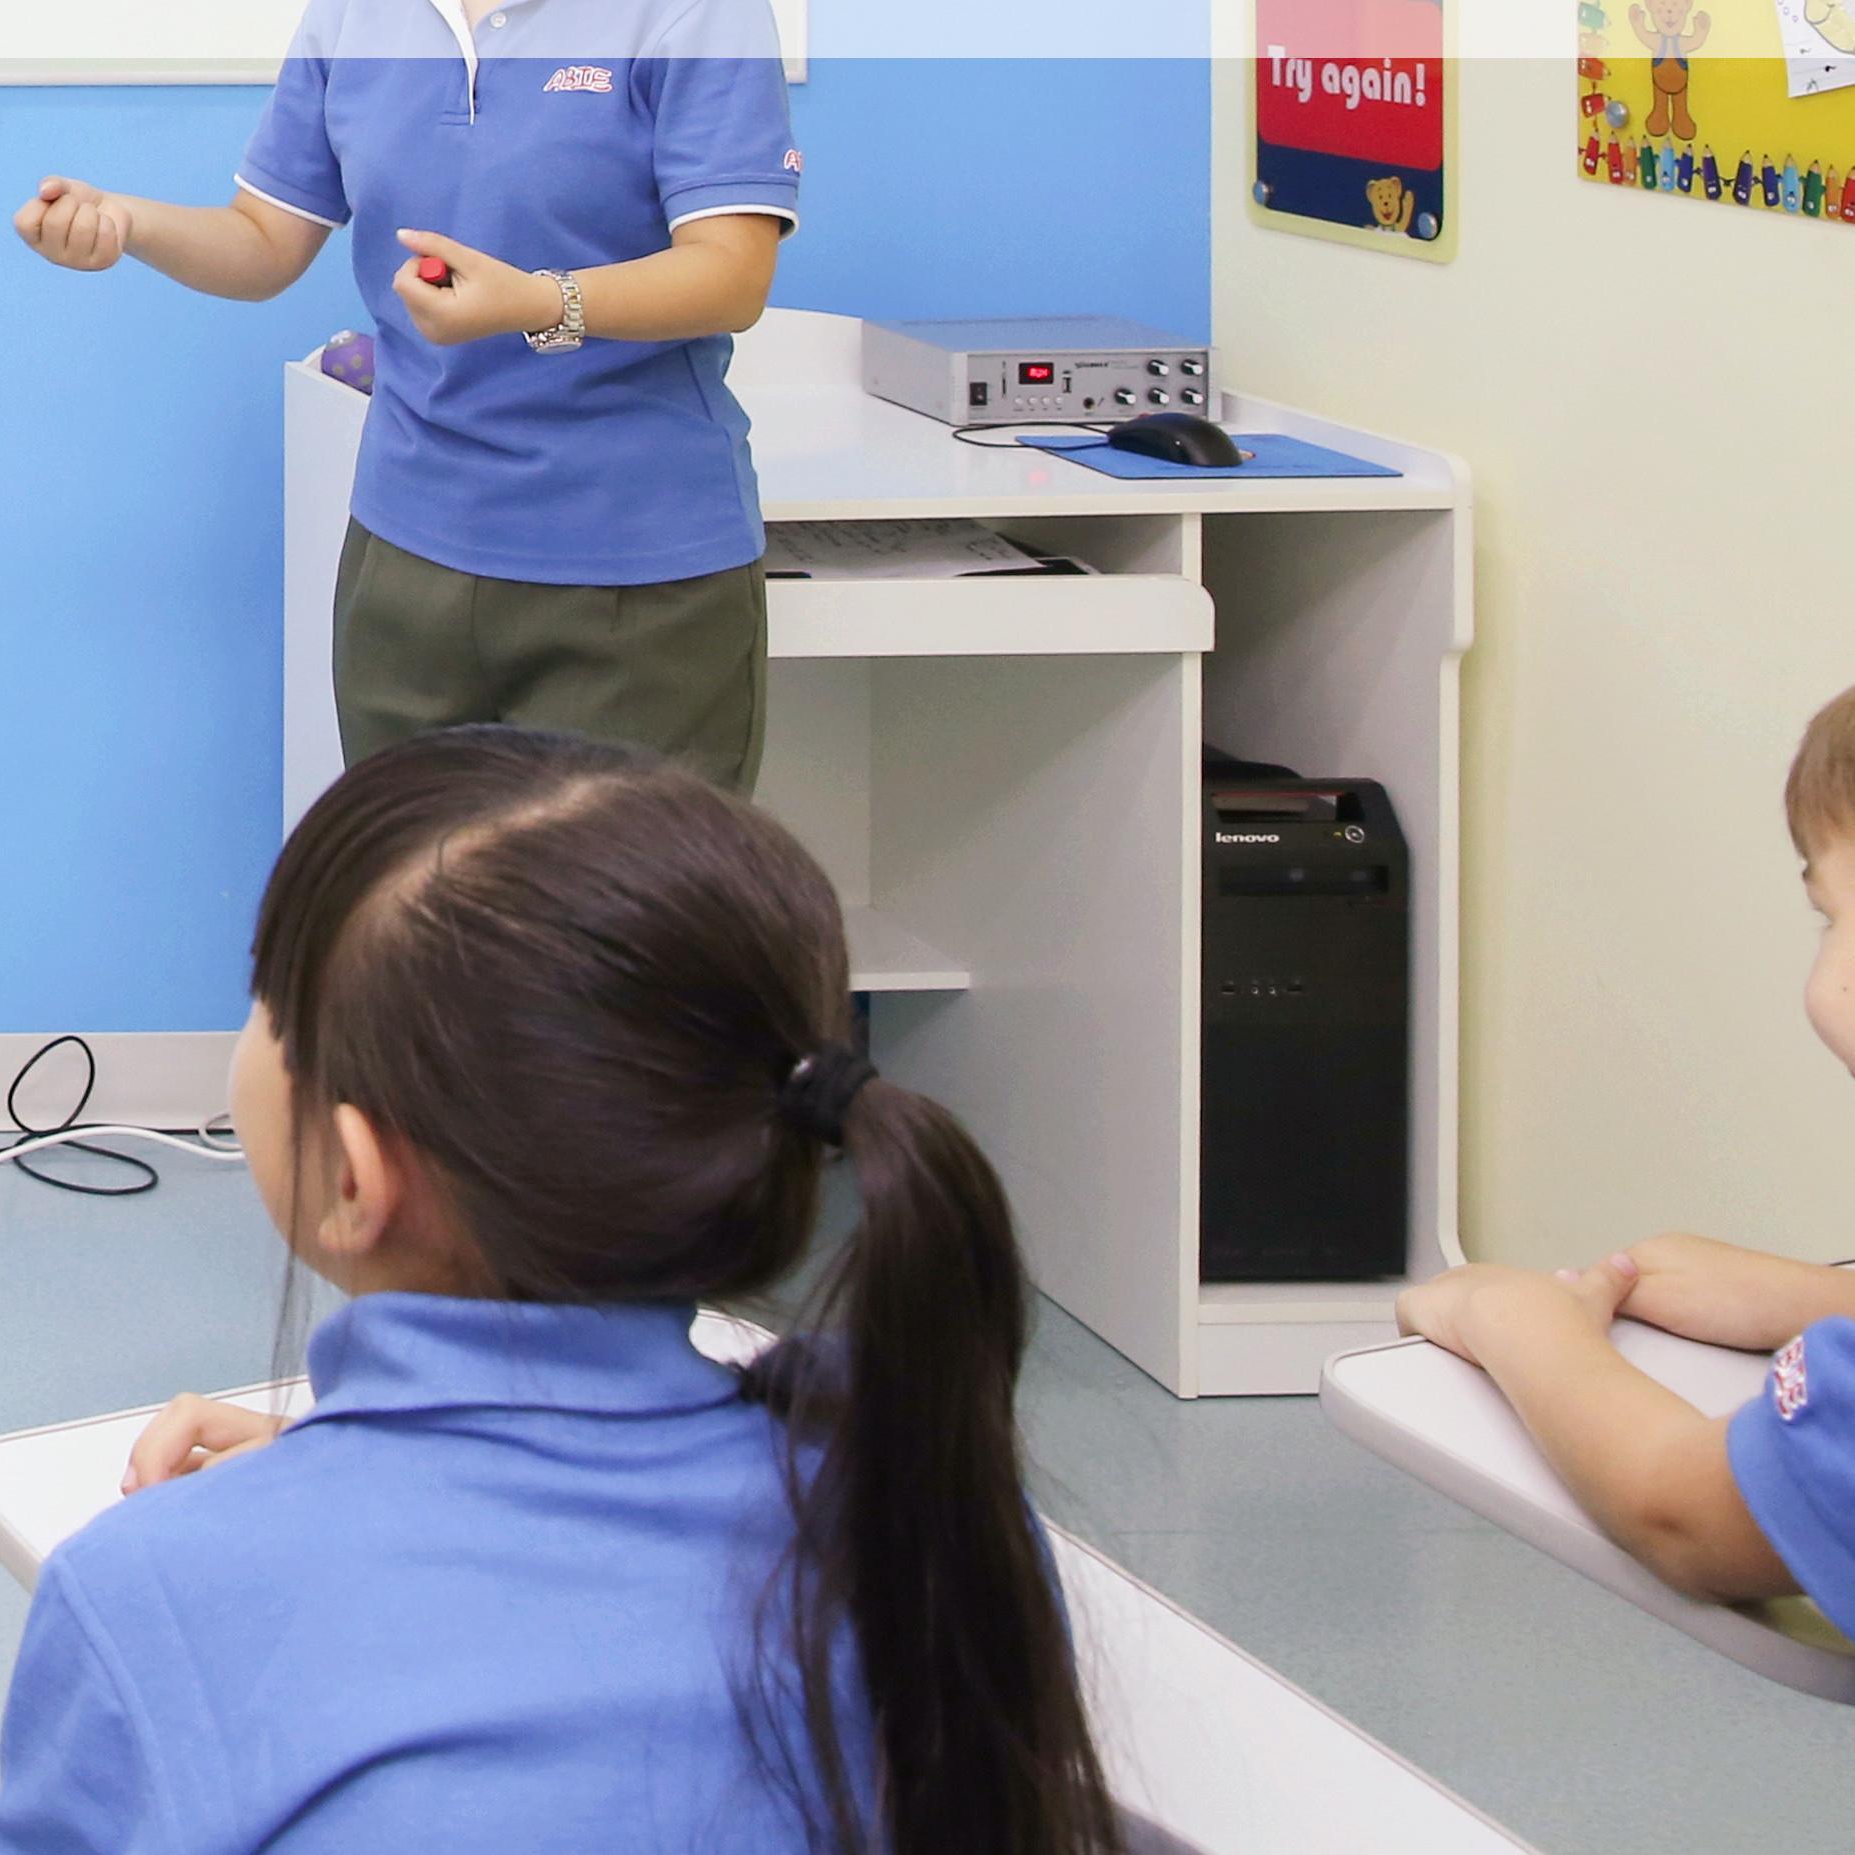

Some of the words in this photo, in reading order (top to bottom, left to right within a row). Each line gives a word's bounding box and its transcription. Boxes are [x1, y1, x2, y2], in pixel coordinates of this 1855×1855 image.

[1267, 45, 1312, 103] Try
[1321, 57, 1426, 110] again!
[1215, 831, 1281, 844] lenovo
